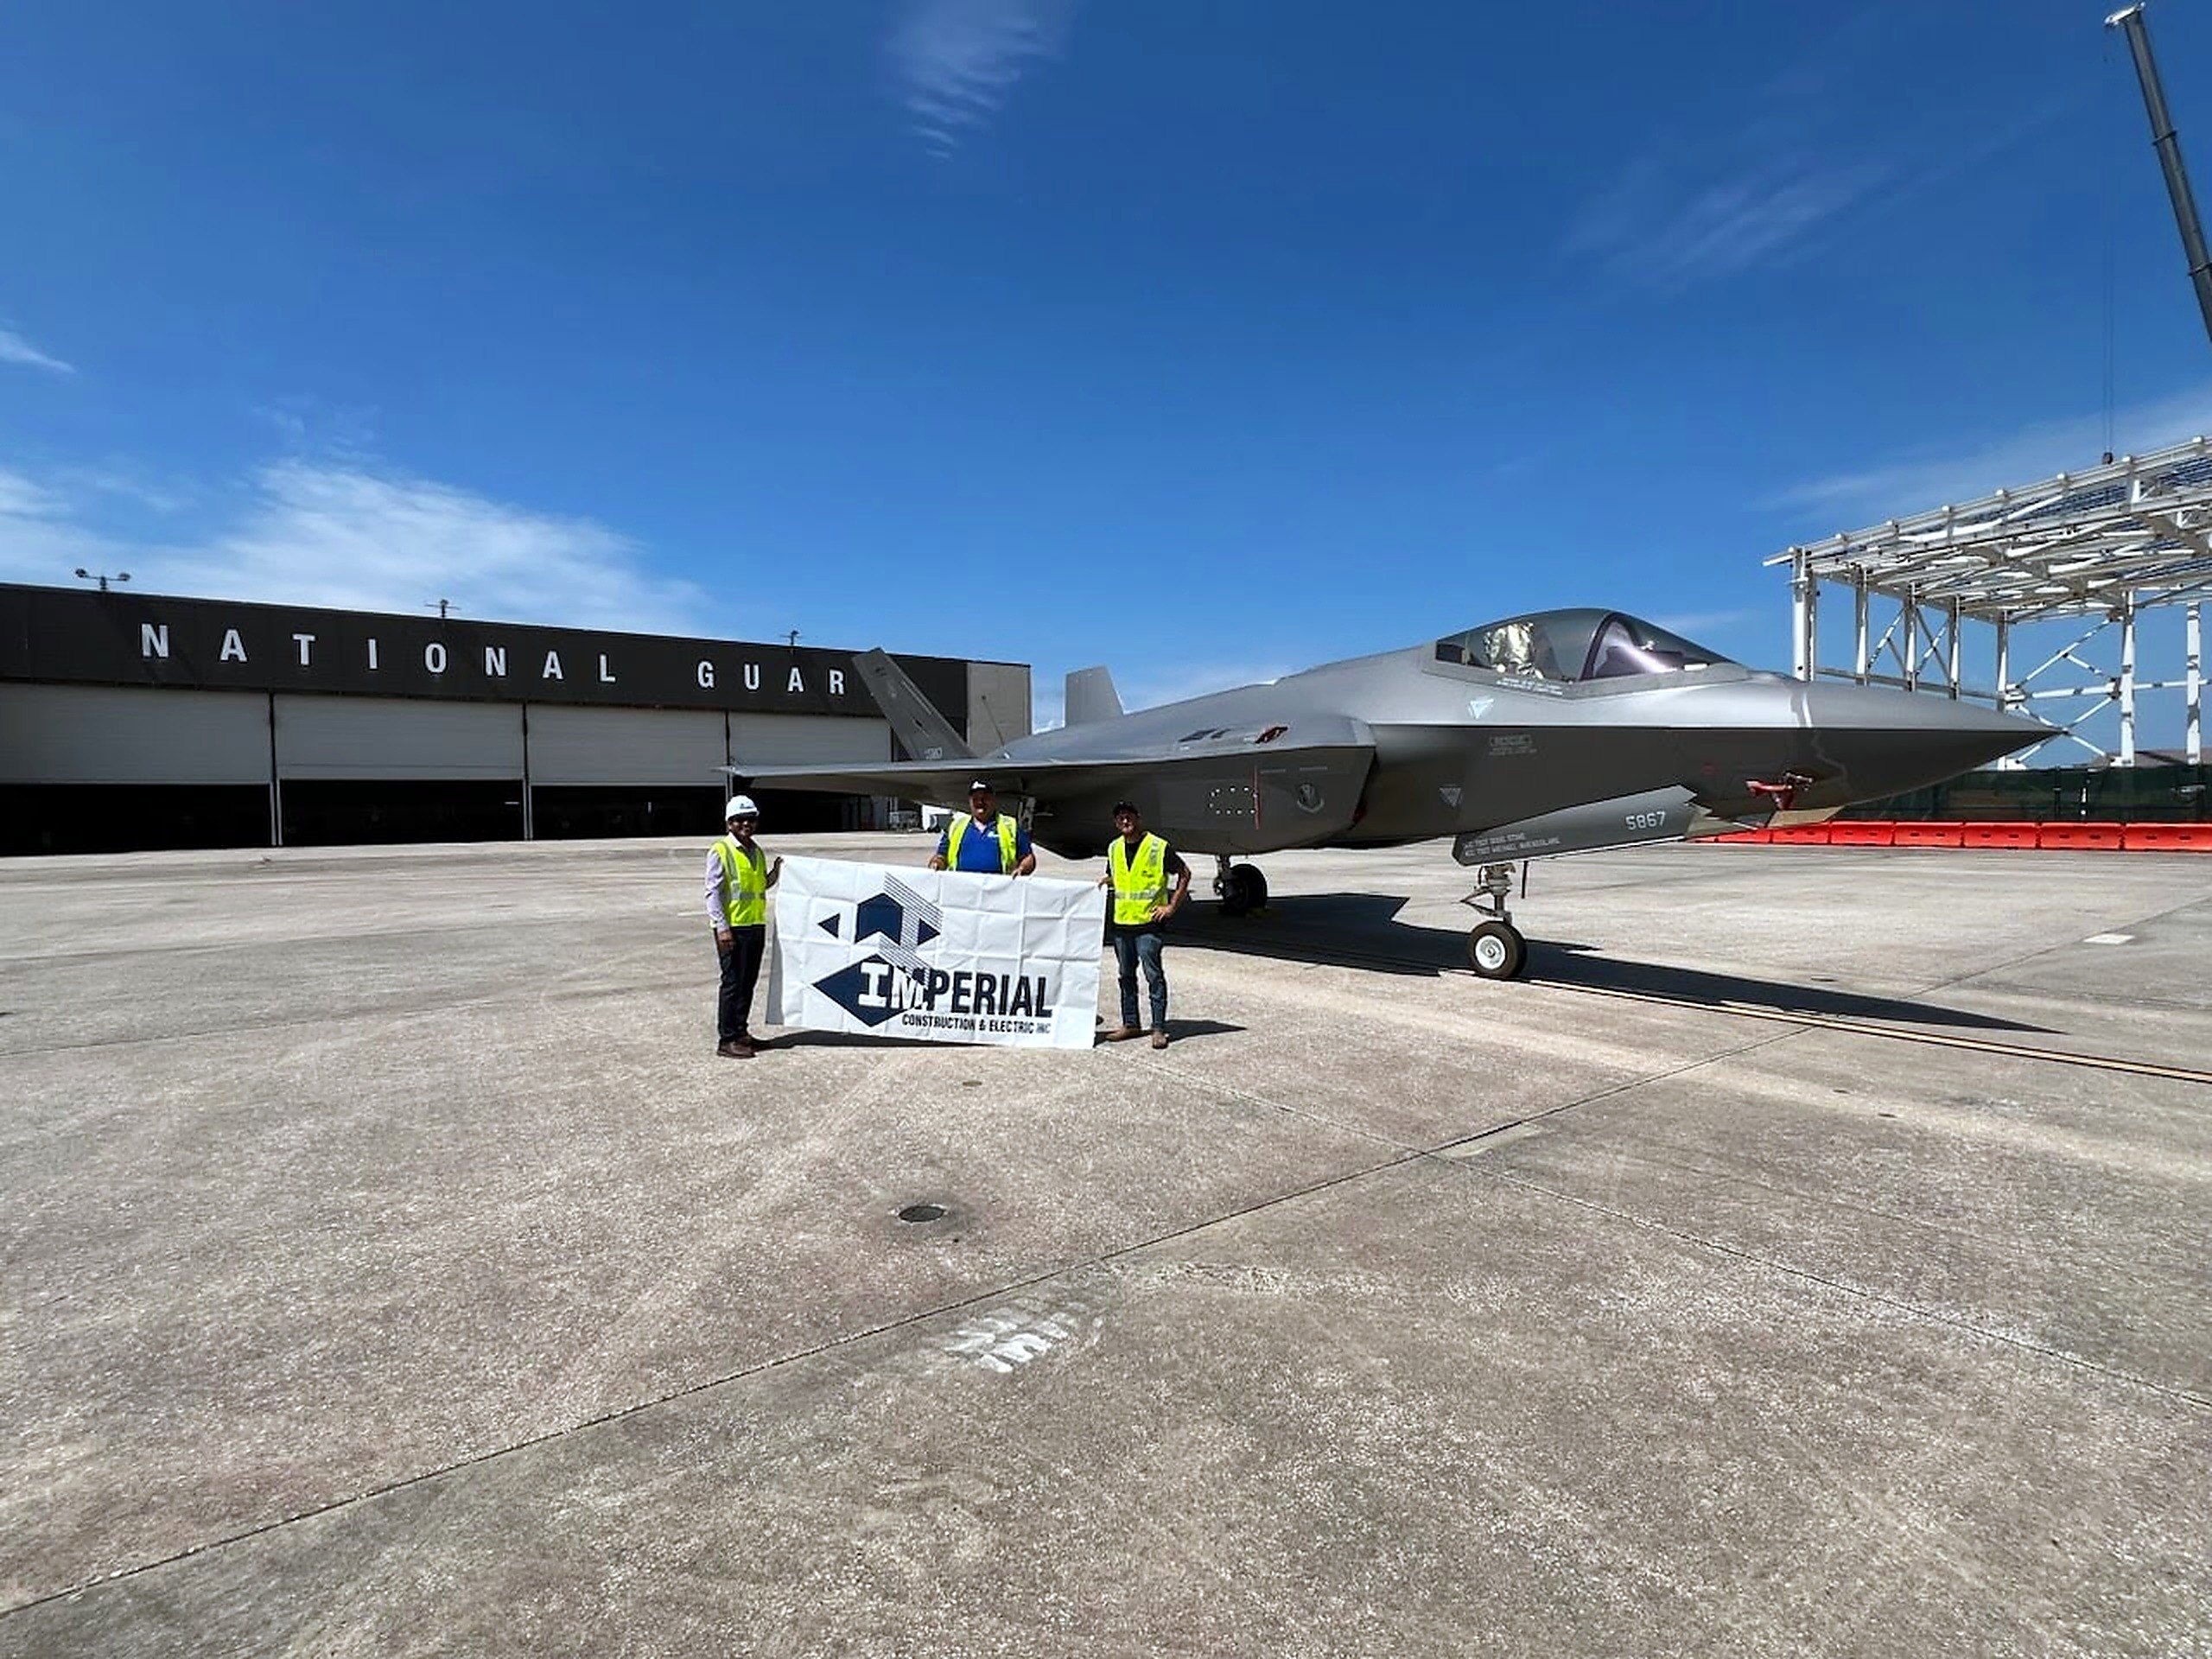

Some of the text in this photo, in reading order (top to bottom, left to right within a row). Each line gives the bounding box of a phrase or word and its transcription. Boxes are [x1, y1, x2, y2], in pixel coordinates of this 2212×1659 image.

[141, 623, 845, 696] NATIONAL GUAR
[1625, 810, 1666, 830] 5867
[858, 961, 1052, 1018] IMPERIAL
[902, 1014, 976, 1031] CONSTRUCTION
[979, 1019, 986, 1031] &
[989, 1020, 1034, 1034] ELECTRIC
